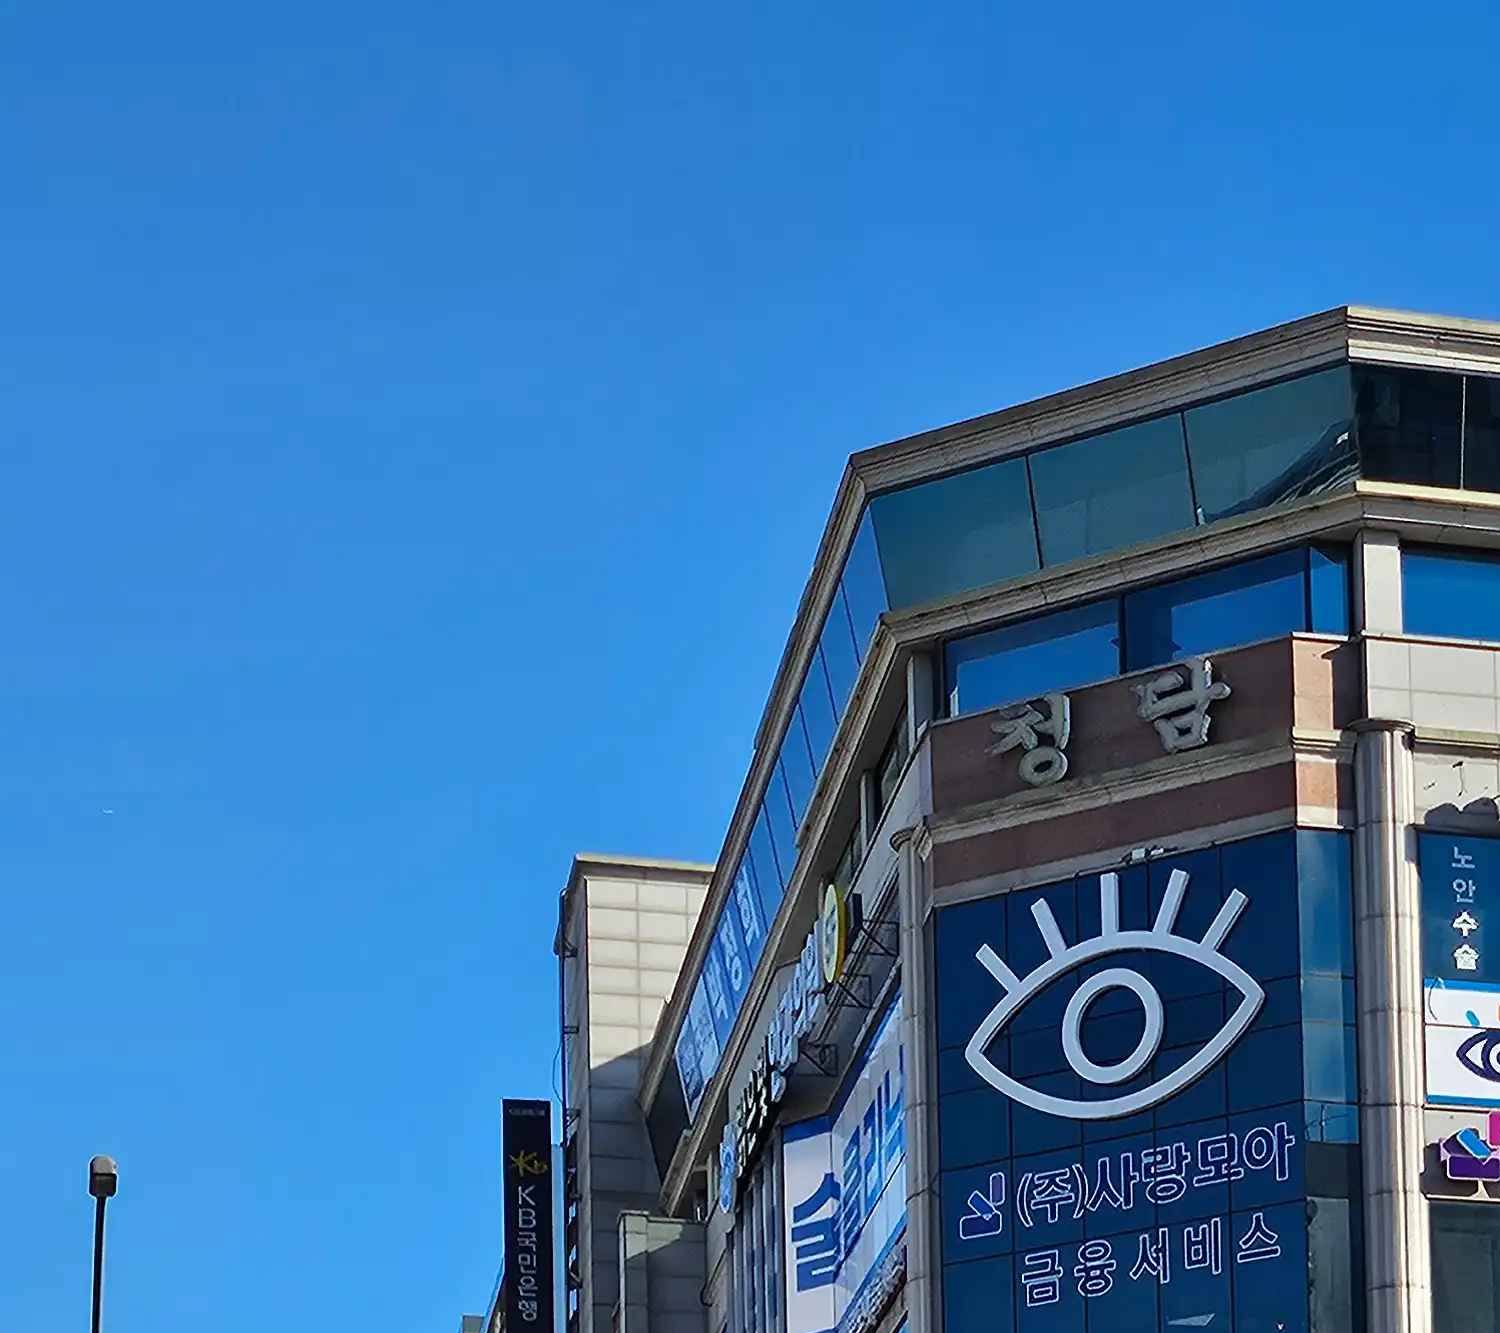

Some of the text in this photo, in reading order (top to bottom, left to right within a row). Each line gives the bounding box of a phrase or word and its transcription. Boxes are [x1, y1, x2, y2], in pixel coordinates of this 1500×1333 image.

[1451, 846, 1480, 972] 노안수술
[1016, 1121, 1296, 1229] (주)사랑모아
[1021, 1212, 1282, 1308] 금융서비스
